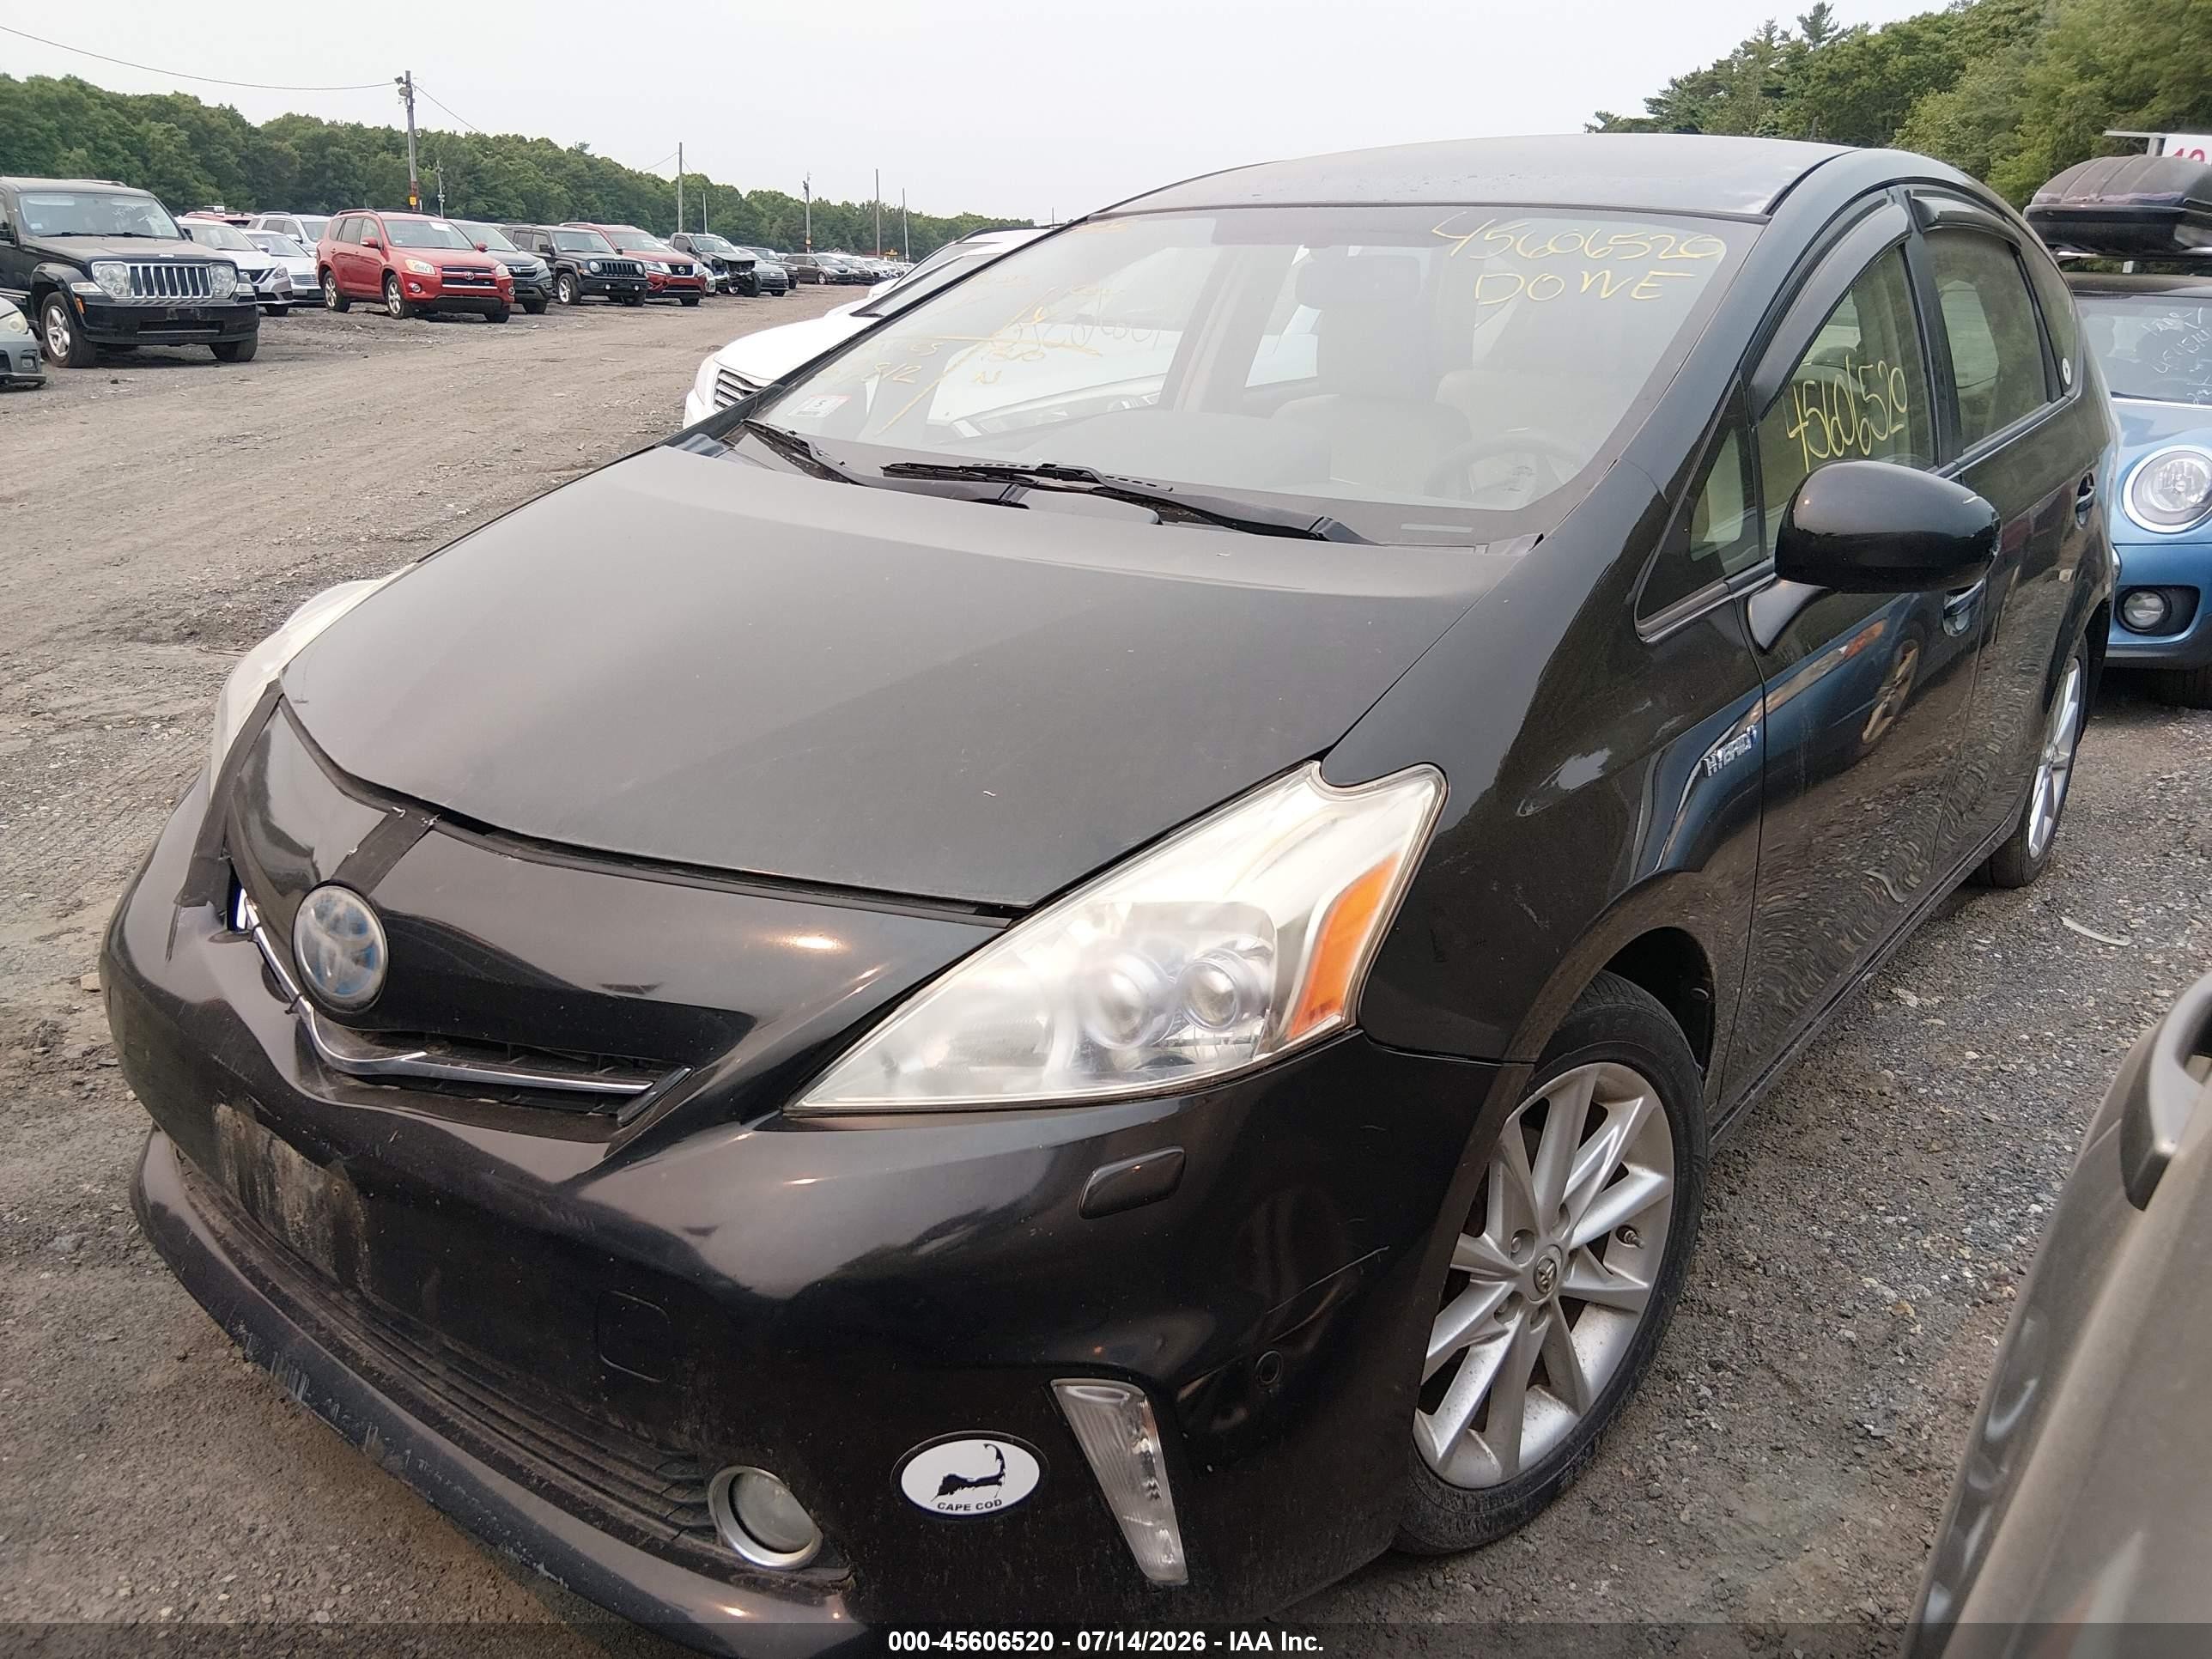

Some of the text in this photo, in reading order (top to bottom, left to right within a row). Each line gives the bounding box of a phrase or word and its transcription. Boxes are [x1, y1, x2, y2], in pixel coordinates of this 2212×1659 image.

[1431, 211, 1728, 260] 45606520
[1781, 354, 1908, 473] 45606520
[937, 1498, 1003, 1511] CAPE COD
